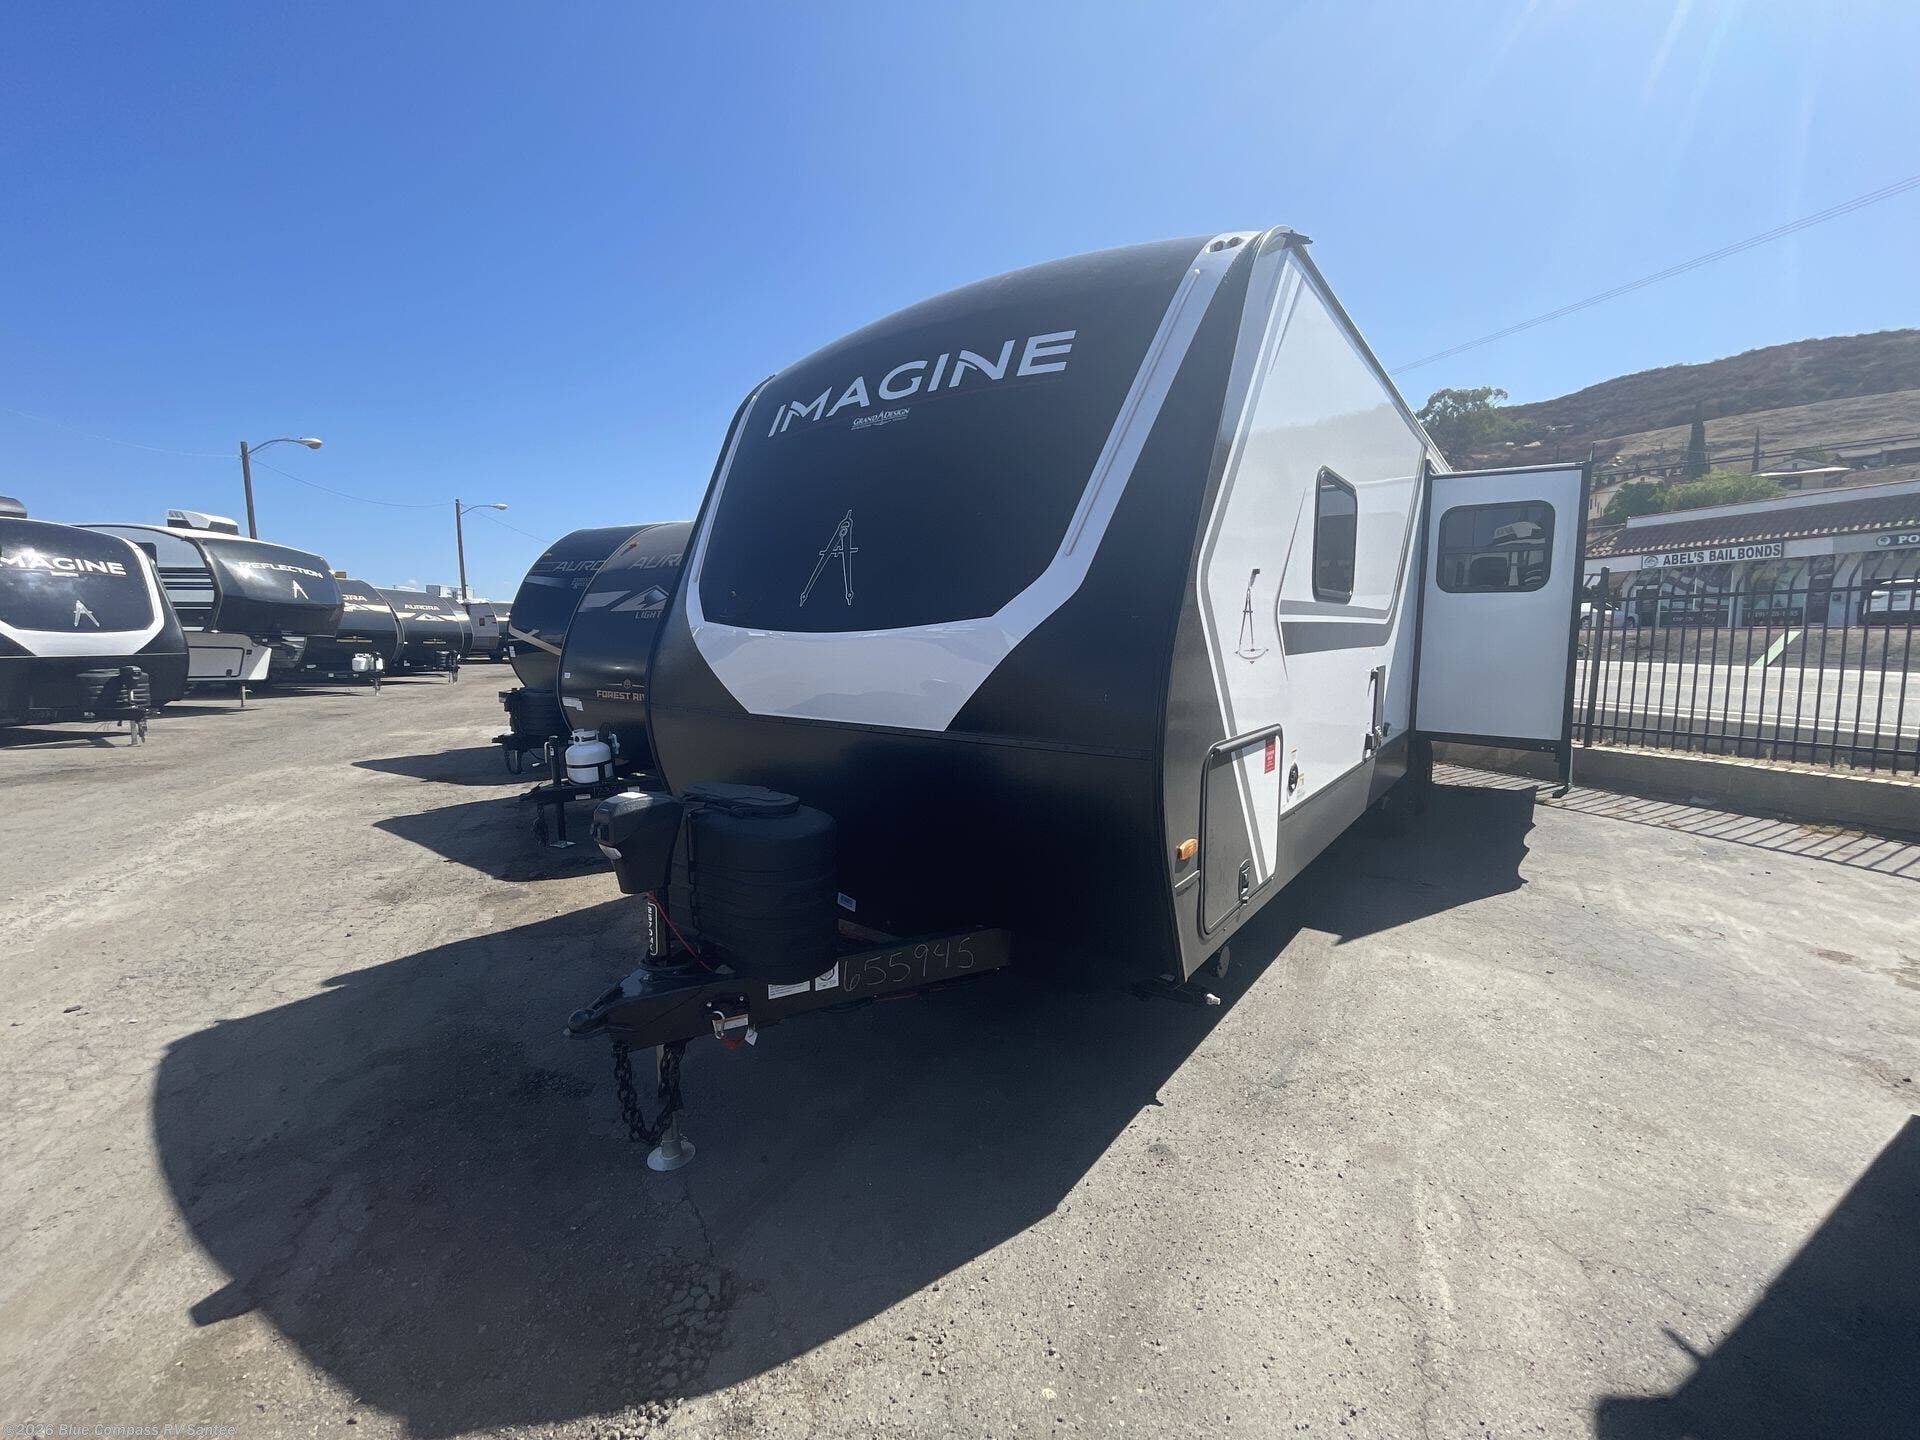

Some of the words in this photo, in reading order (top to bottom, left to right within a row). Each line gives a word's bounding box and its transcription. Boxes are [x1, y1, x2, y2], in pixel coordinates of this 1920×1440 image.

[768, 329, 1077, 438] IMAGINE
[1663, 550, 1705, 566] ABEL'S
[1708, 547, 1735, 562] BAIL
[1737, 544, 1781, 560] BONDS
[239, 561, 324, 579] REFLECTION
[596, 689, 630, 700] FOREST
[842, 936, 975, 992] 655945
